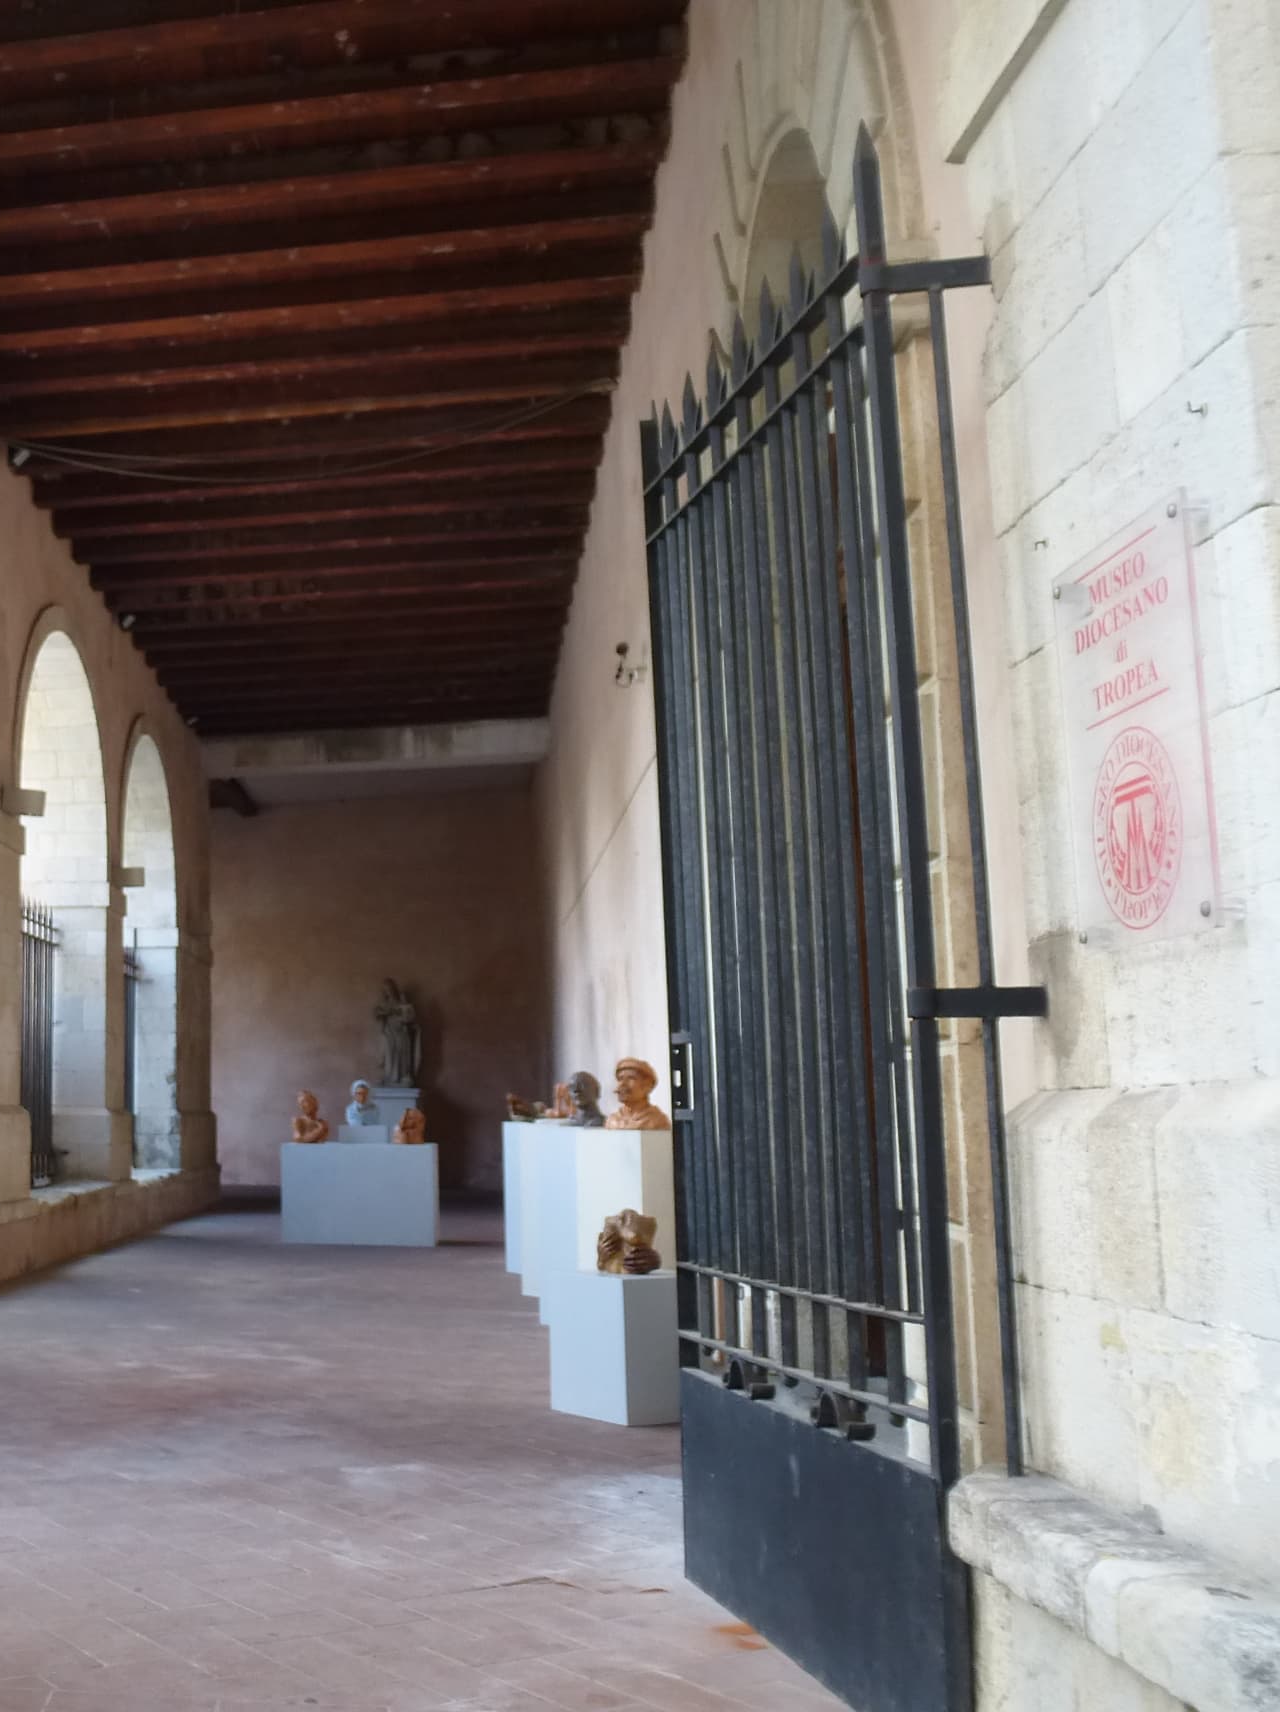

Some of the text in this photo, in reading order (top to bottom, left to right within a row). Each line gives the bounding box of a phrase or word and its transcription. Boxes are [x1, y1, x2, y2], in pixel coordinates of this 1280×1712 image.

[1087, 551, 1146, 607] MUSEO
[1074, 575, 1169, 656] DIOCESANO
[1114, 639, 1129, 664] di
[1092, 658, 1159, 712] TROPEA
